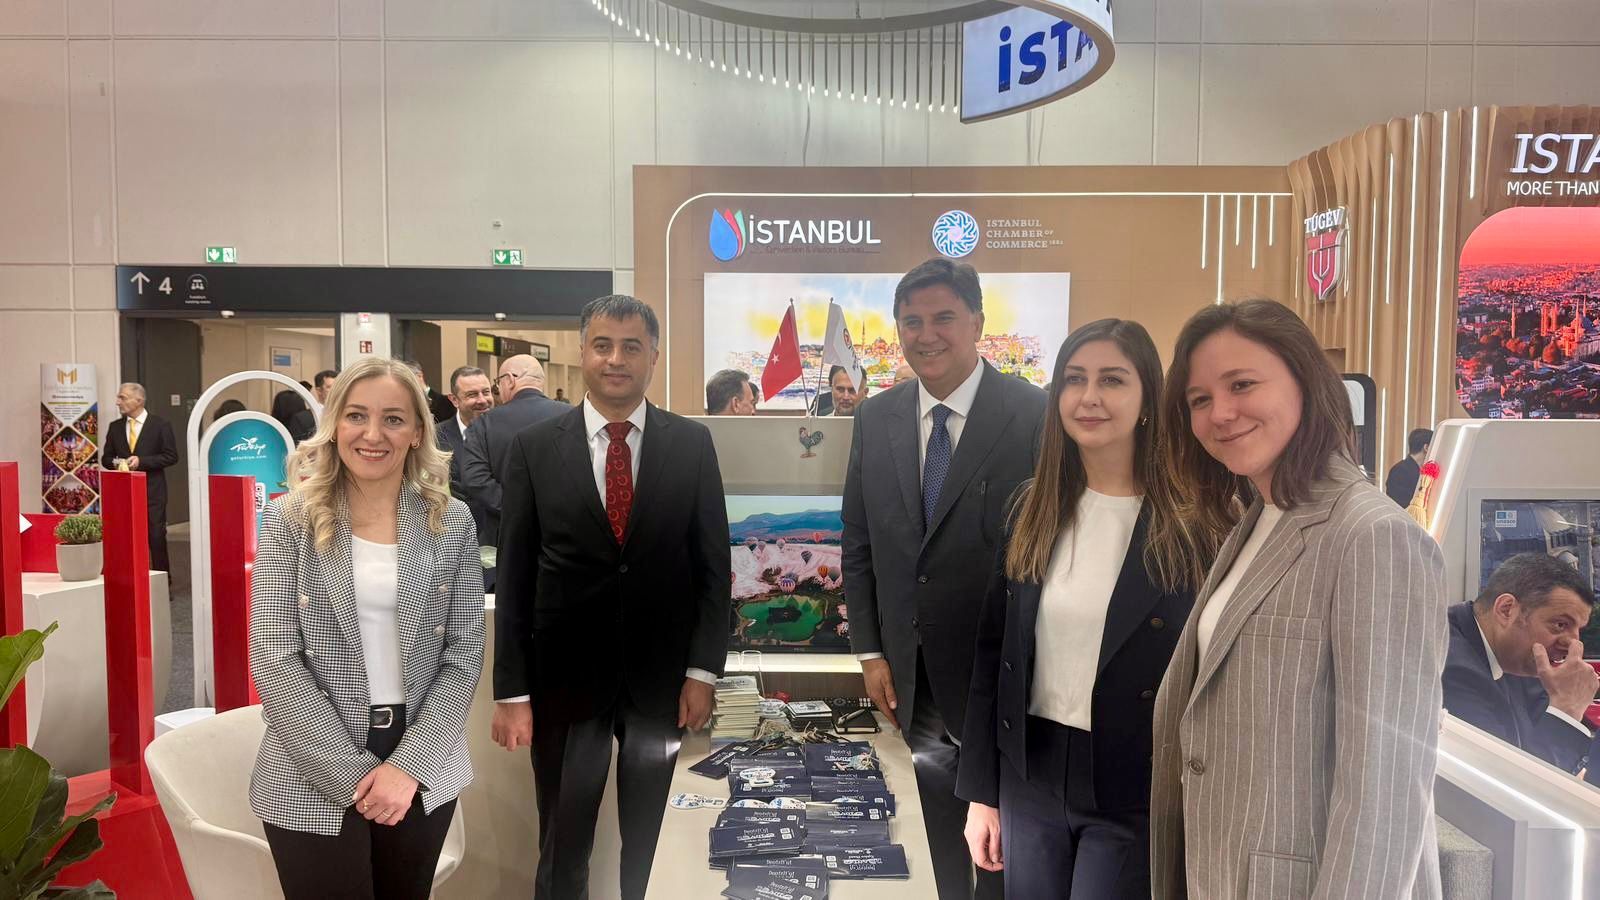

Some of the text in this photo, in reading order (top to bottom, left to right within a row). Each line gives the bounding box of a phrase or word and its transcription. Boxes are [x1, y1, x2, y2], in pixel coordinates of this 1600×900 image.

[1507, 181, 1599, 196] MORE THAN
[750, 214, 881, 244] İSTANBUL
[986, 219, 1041, 227] ISTANBUL
[986, 230, 1043, 238] CHAMBER
[986, 240, 1048, 249] COMMERCE
[159, 277, 172, 294] 4
